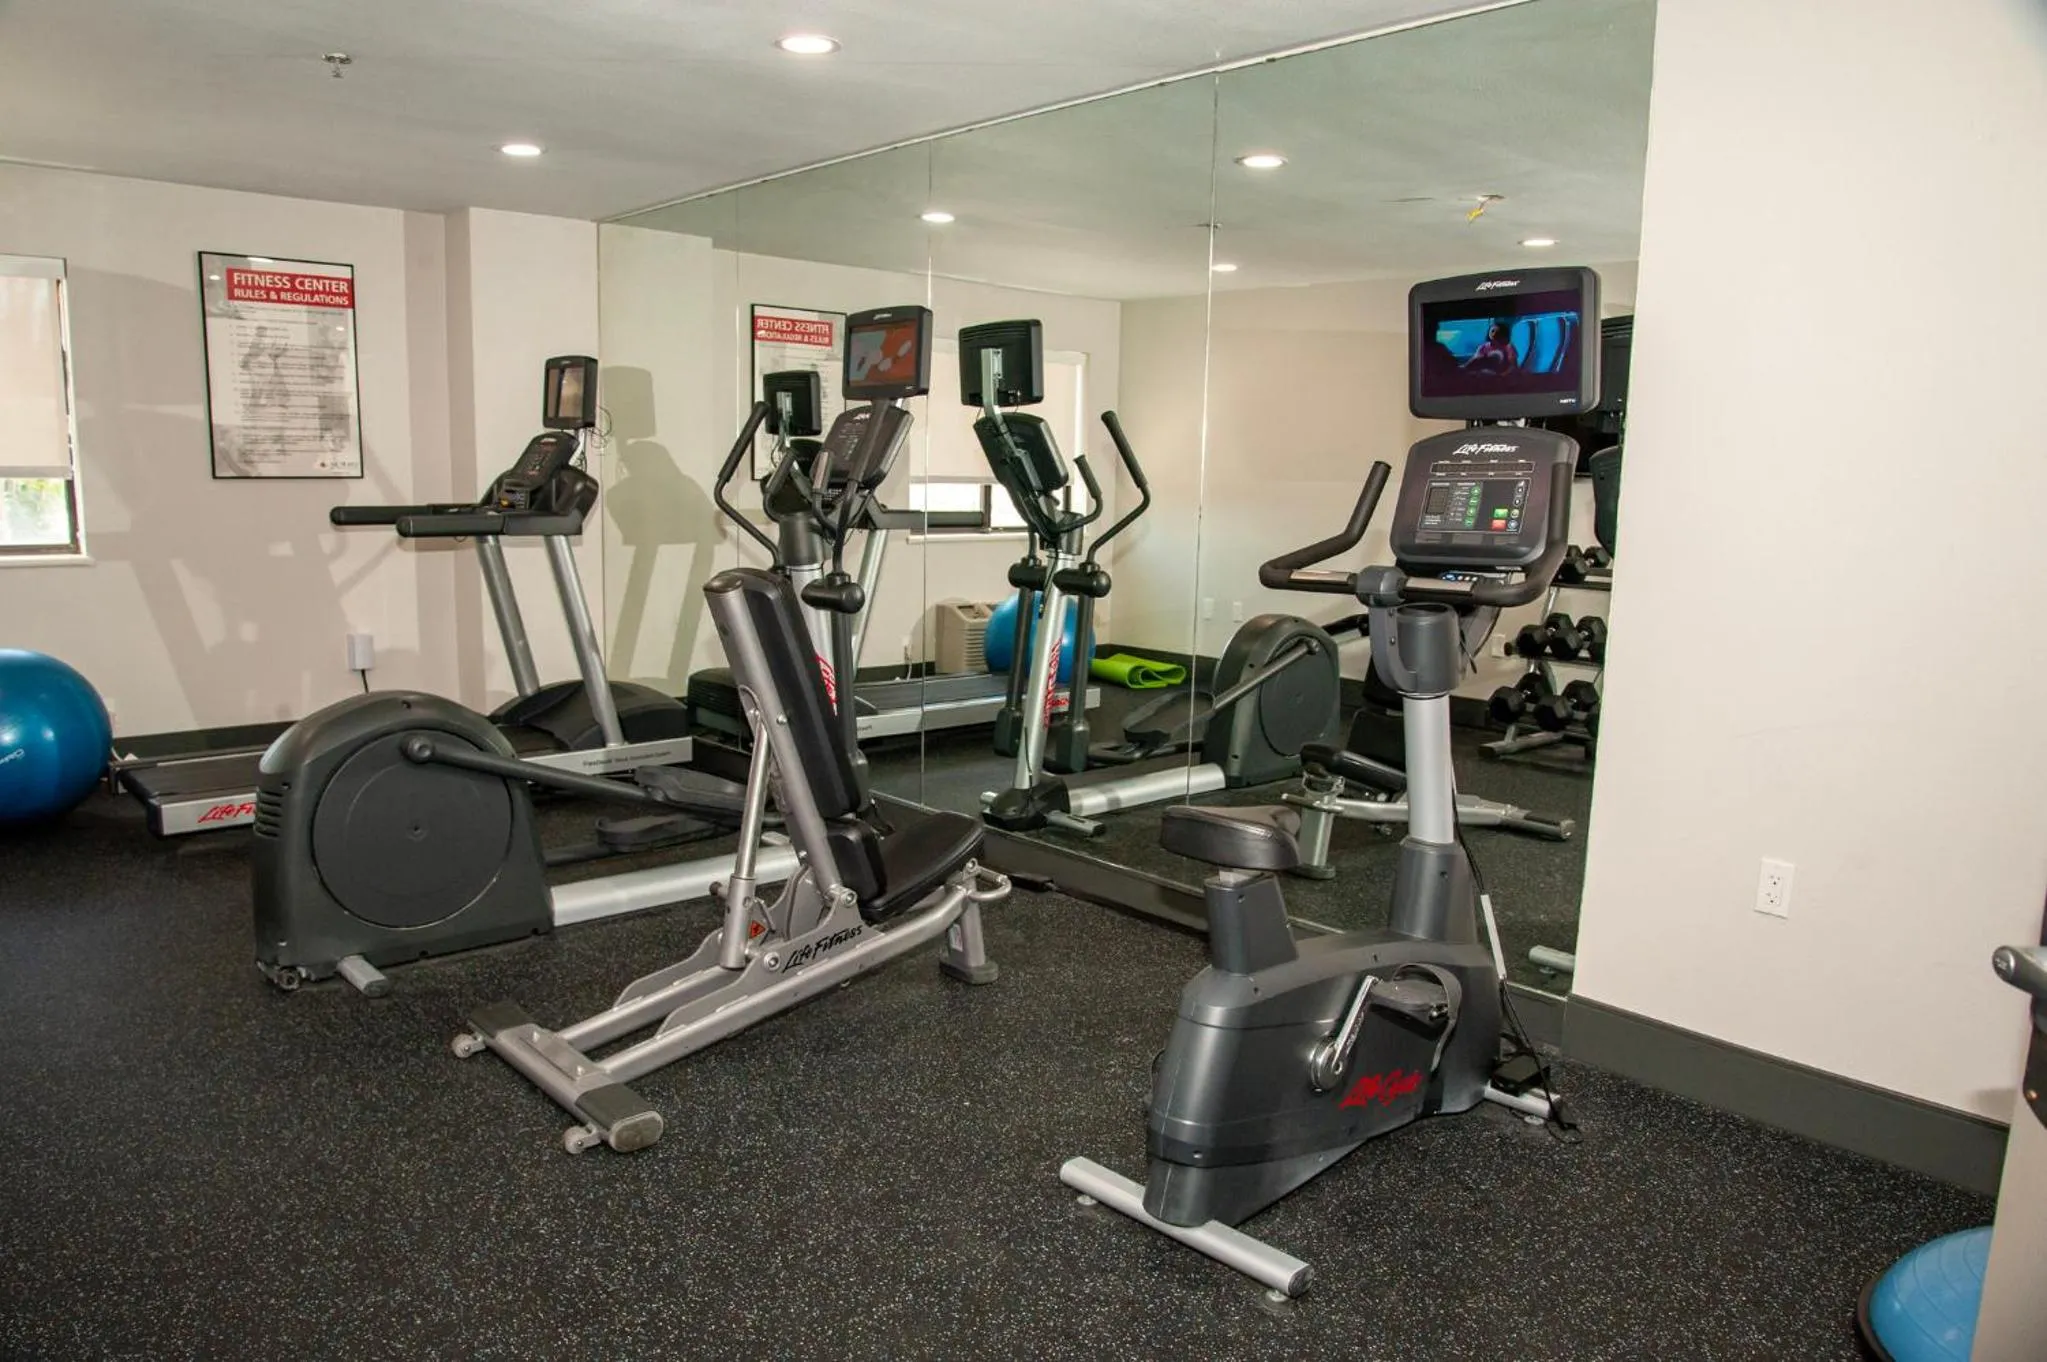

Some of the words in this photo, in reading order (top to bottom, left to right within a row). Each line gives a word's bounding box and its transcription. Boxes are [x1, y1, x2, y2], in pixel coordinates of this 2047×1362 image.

[233, 272, 291, 289] FITNESS
[295, 277, 349, 293] CENTER
[234, 288, 267, 299] RULES
[269, 290, 278, 300] &
[280, 291, 349, 305] REGULATIONS
